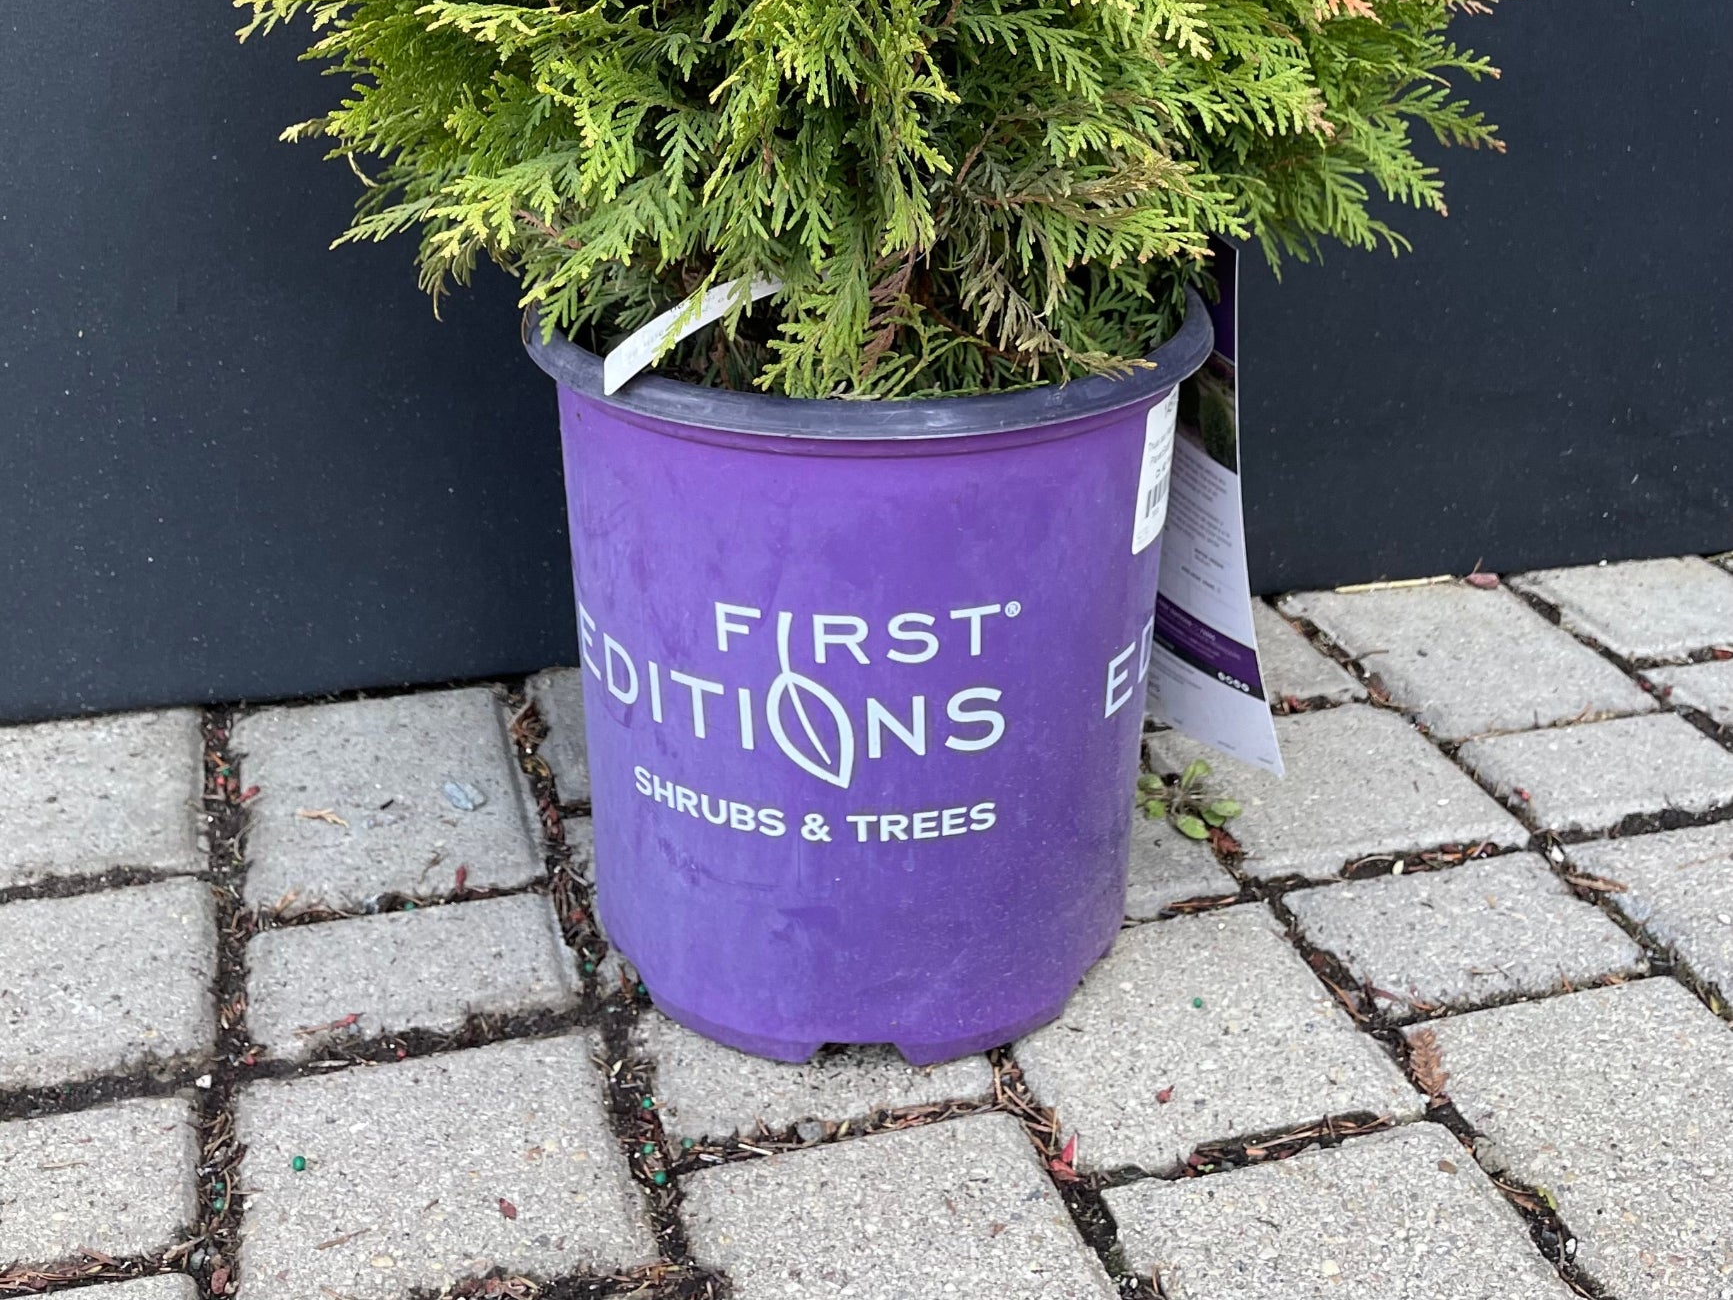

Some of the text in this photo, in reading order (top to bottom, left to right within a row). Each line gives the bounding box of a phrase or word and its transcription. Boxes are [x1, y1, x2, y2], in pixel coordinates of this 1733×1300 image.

[577, 600, 1006, 789] EDITIONS
[633, 765, 997, 843] SHRUBS & TREES
